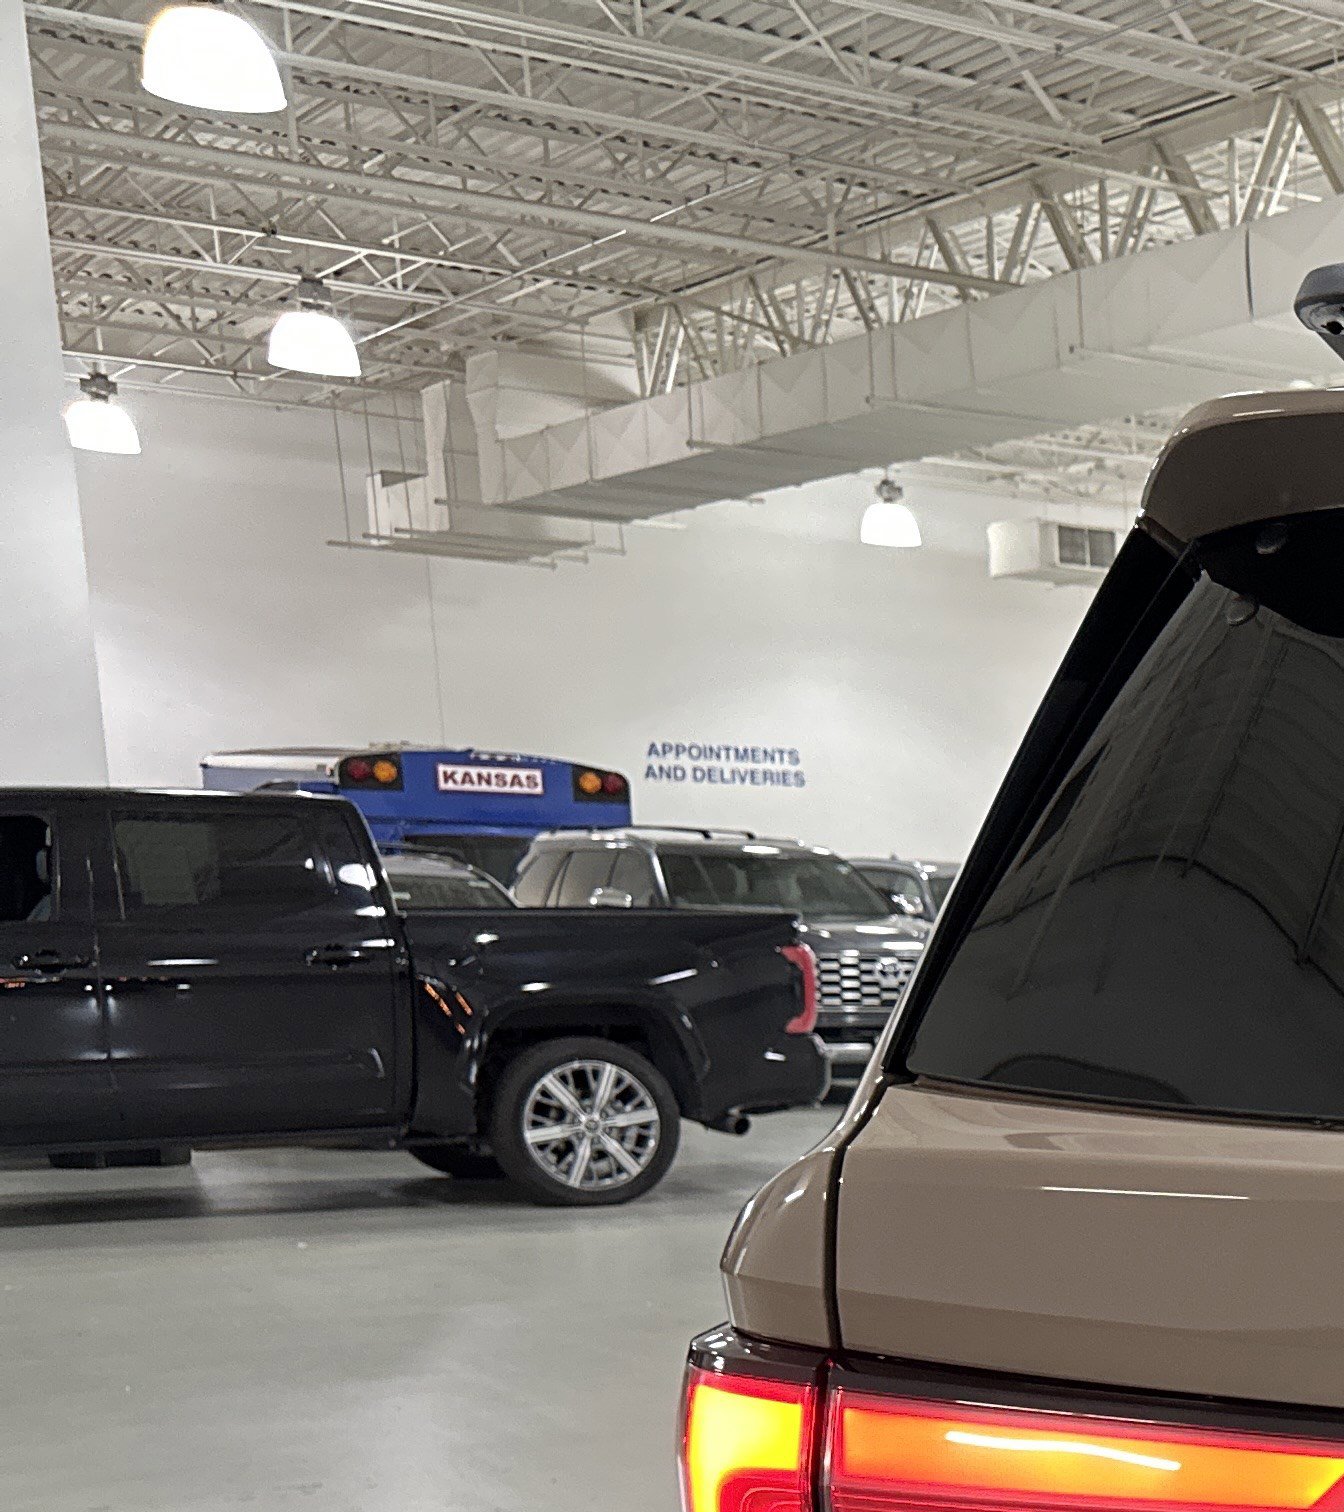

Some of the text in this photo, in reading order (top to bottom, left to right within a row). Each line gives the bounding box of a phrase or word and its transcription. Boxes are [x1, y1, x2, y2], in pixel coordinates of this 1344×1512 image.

[648, 742, 800, 765] APPOINTMENTS
[442, 769, 539, 789] KANSAS
[645, 764, 805, 788] AND DELIVERIES
